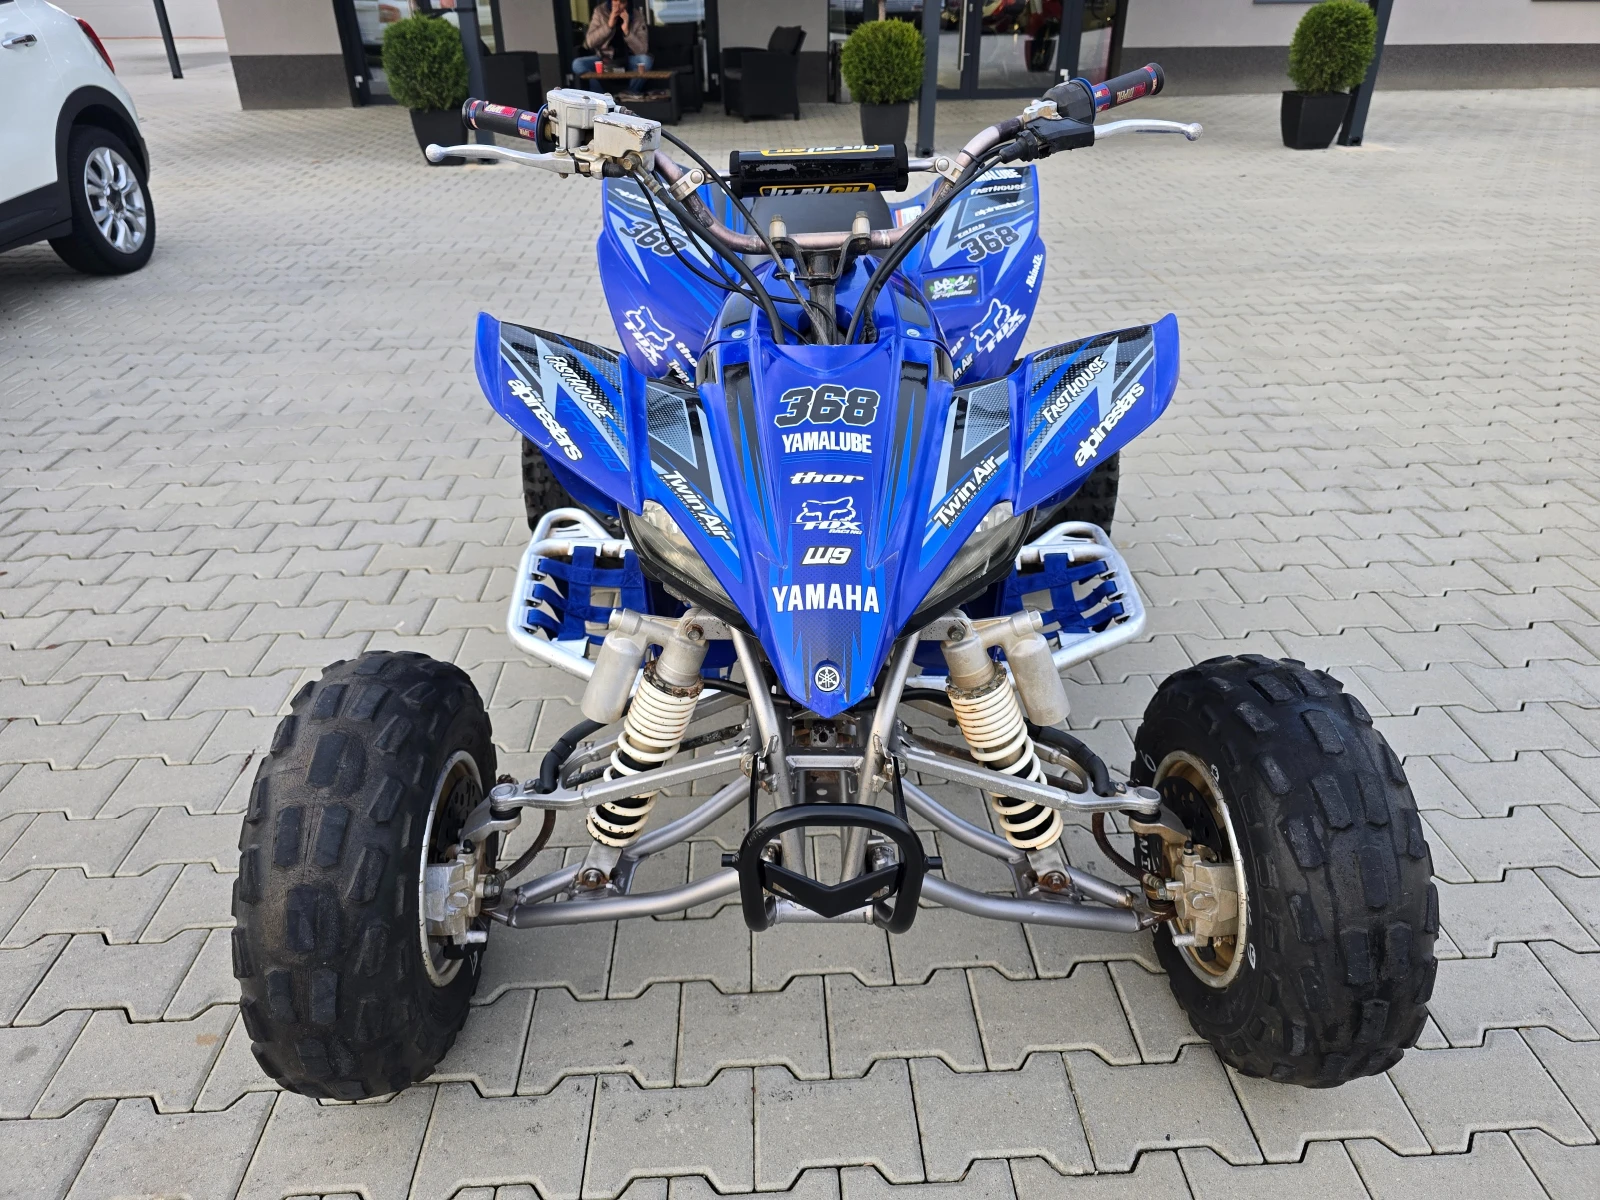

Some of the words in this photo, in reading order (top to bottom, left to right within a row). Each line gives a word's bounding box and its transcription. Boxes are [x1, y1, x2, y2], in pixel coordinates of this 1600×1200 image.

[970, 182, 1027, 196] FASTHOUSE
[975, 168, 1022, 182] MALUBE
[619, 220, 688, 256] 368
[959, 225, 1021, 263] 368
[675, 341, 697, 368] tho
[950, 336, 965, 358] or
[545, 354, 614, 421] FASTHOUSE
[1041, 356, 1108, 424] FASTHOUSE
[508, 379, 582, 461] alpinestars
[774, 384, 881, 428] 368
[781, 431, 873, 454] YAMALUBE
[1074, 383, 1145, 467] alpinestars
[790, 471, 864, 485] thor
[933, 480, 977, 525] Twin
[973, 455, 997, 486] Air
[663, 470, 706, 511] Twin
[697, 512, 731, 540] Air
[801, 520, 862, 531] FOX
[772, 583, 880, 613] YAMAHA
